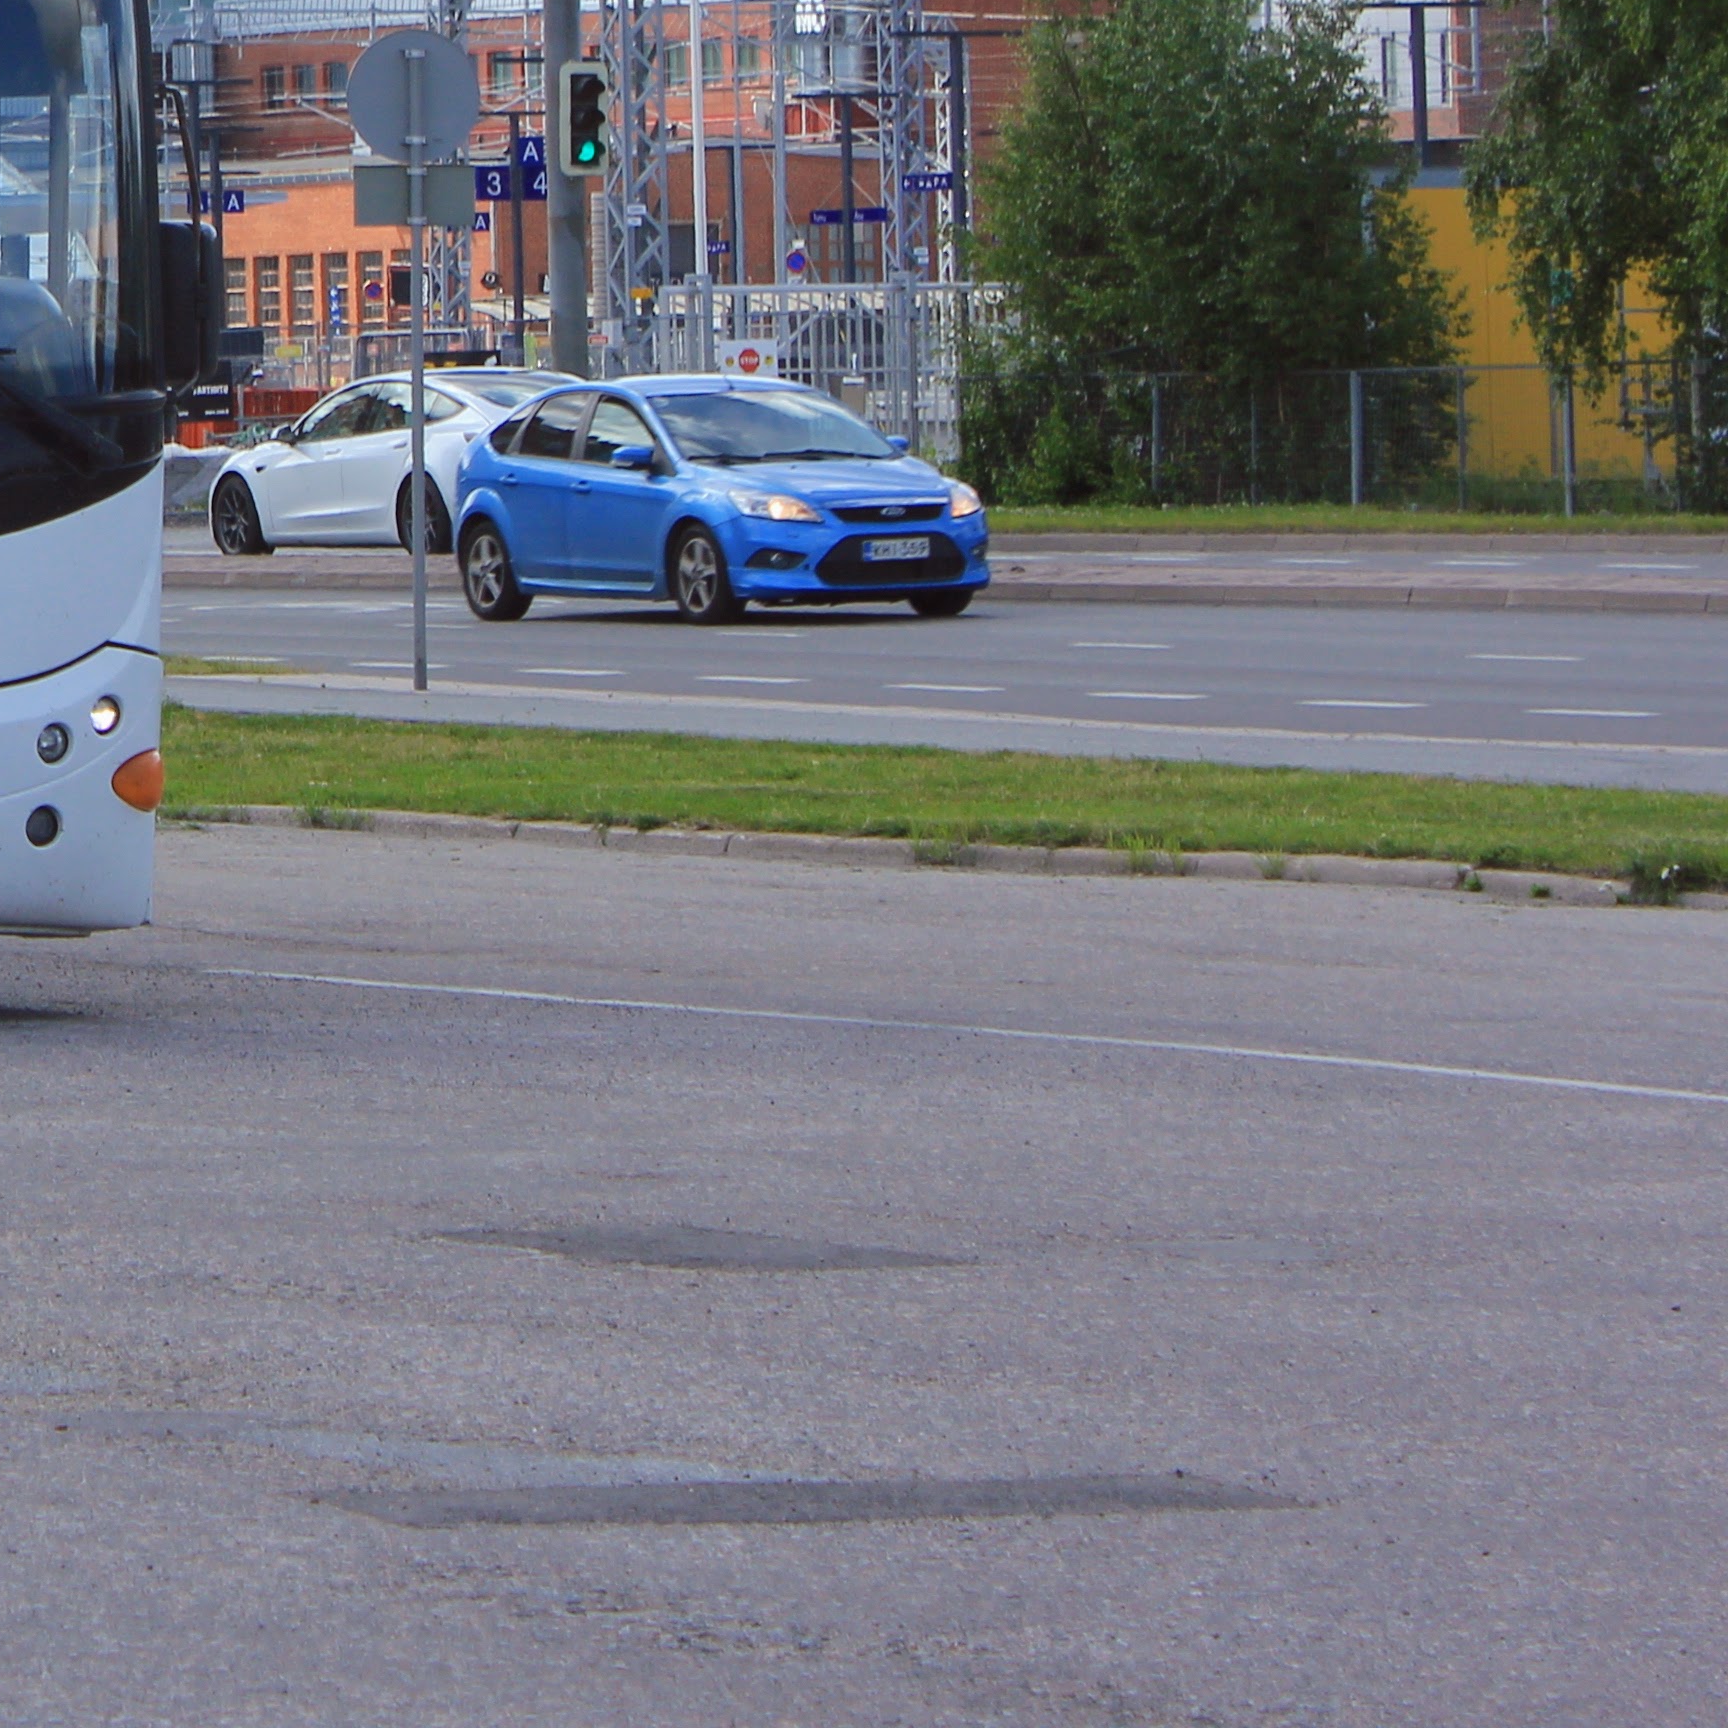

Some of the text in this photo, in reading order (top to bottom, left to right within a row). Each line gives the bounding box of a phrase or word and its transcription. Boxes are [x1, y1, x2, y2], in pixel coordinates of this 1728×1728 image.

[522, 140, 539, 162] A
[486, 171, 501, 196] 3
[533, 171, 547, 195] 4
[227, 193, 240, 211] A
[475, 215, 487, 230] A
